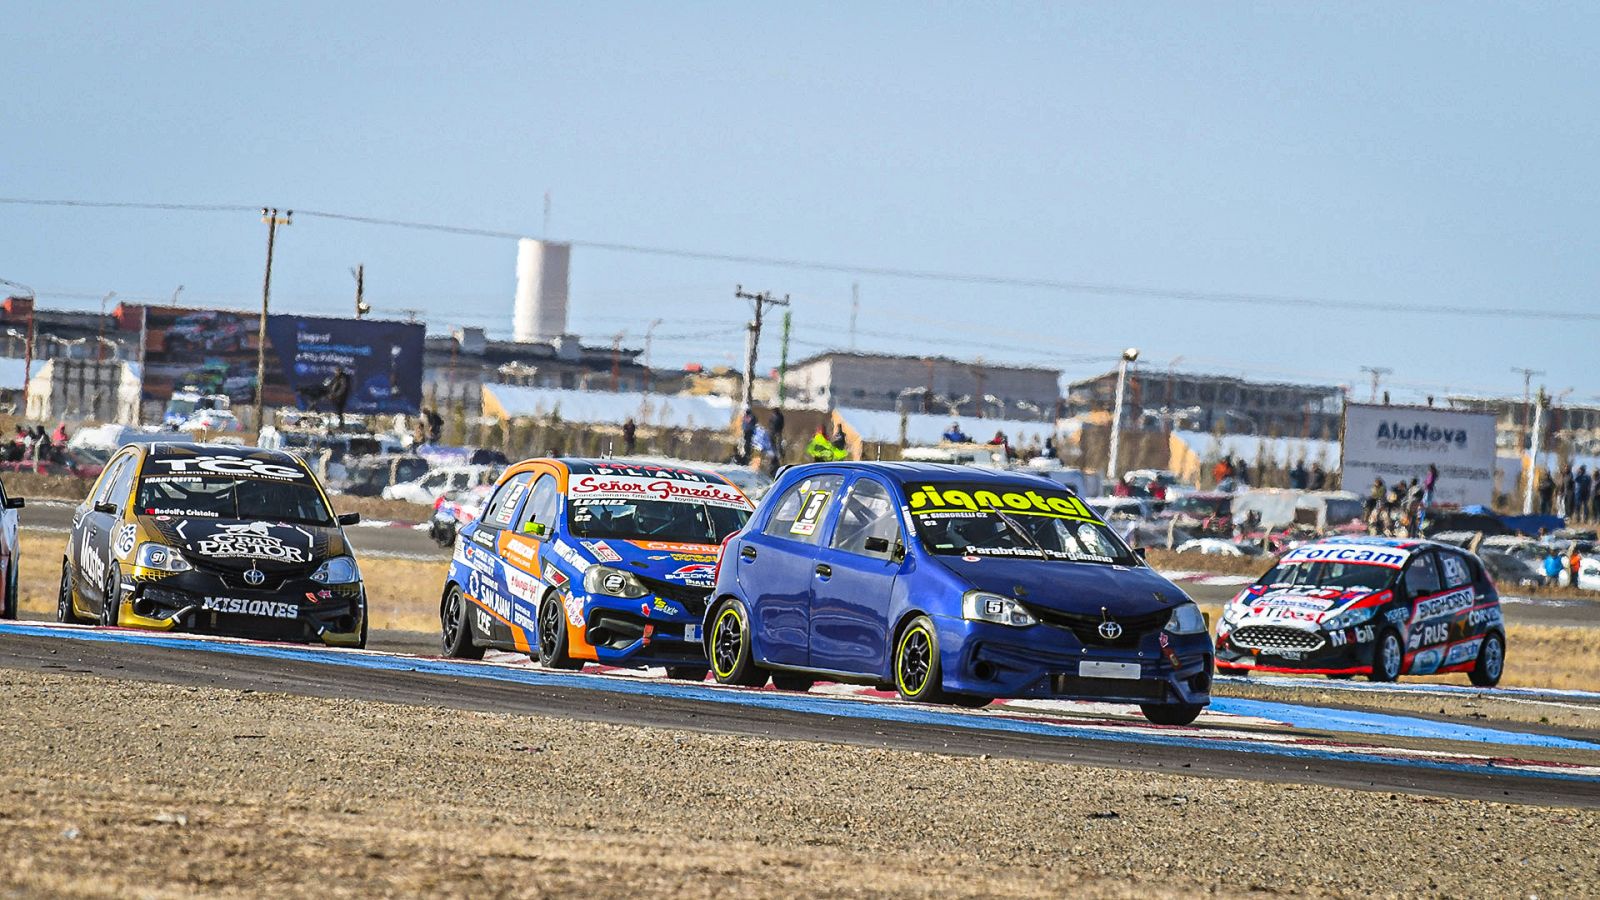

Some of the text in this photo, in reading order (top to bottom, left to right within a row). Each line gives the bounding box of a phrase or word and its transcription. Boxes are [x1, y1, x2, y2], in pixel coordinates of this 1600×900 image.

[1377, 421, 1468, 443] AluNova
[154, 459, 305, 478] TCG
[572, 477, 747, 502] Señor González
[154, 508, 185, 516] Rodolfo
[804, 493, 826, 520] 5
[197, 541, 306, 562] PASTOR
[212, 535, 282, 547] GRAN
[966, 545, 1043, 558] Parabrisas
[151, 552, 165, 562] 91
[1289, 548, 1404, 564] Forcam
[201, 597, 299, 618] MISIONES
[1329, 625, 1376, 648] Mobil
[1423, 622, 1449, 645] RUS
